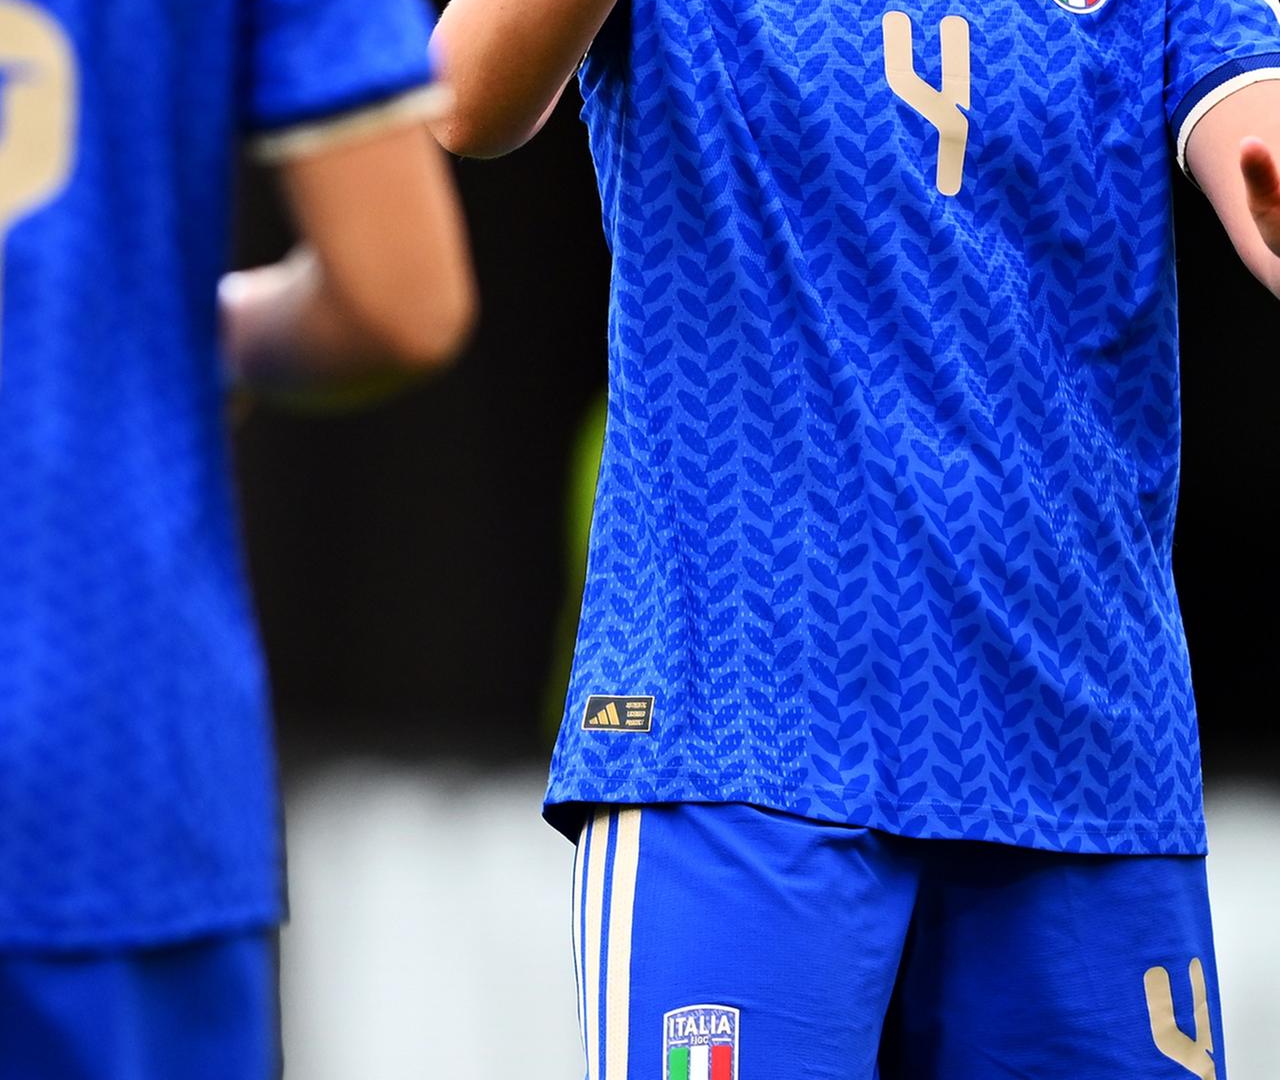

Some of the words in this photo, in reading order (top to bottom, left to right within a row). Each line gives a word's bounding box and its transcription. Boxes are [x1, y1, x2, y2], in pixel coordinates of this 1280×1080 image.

[882, 9, 971, 197] 4
[669, 1015, 732, 1037] ITALIA
[1143, 956, 1218, 1080] 4
